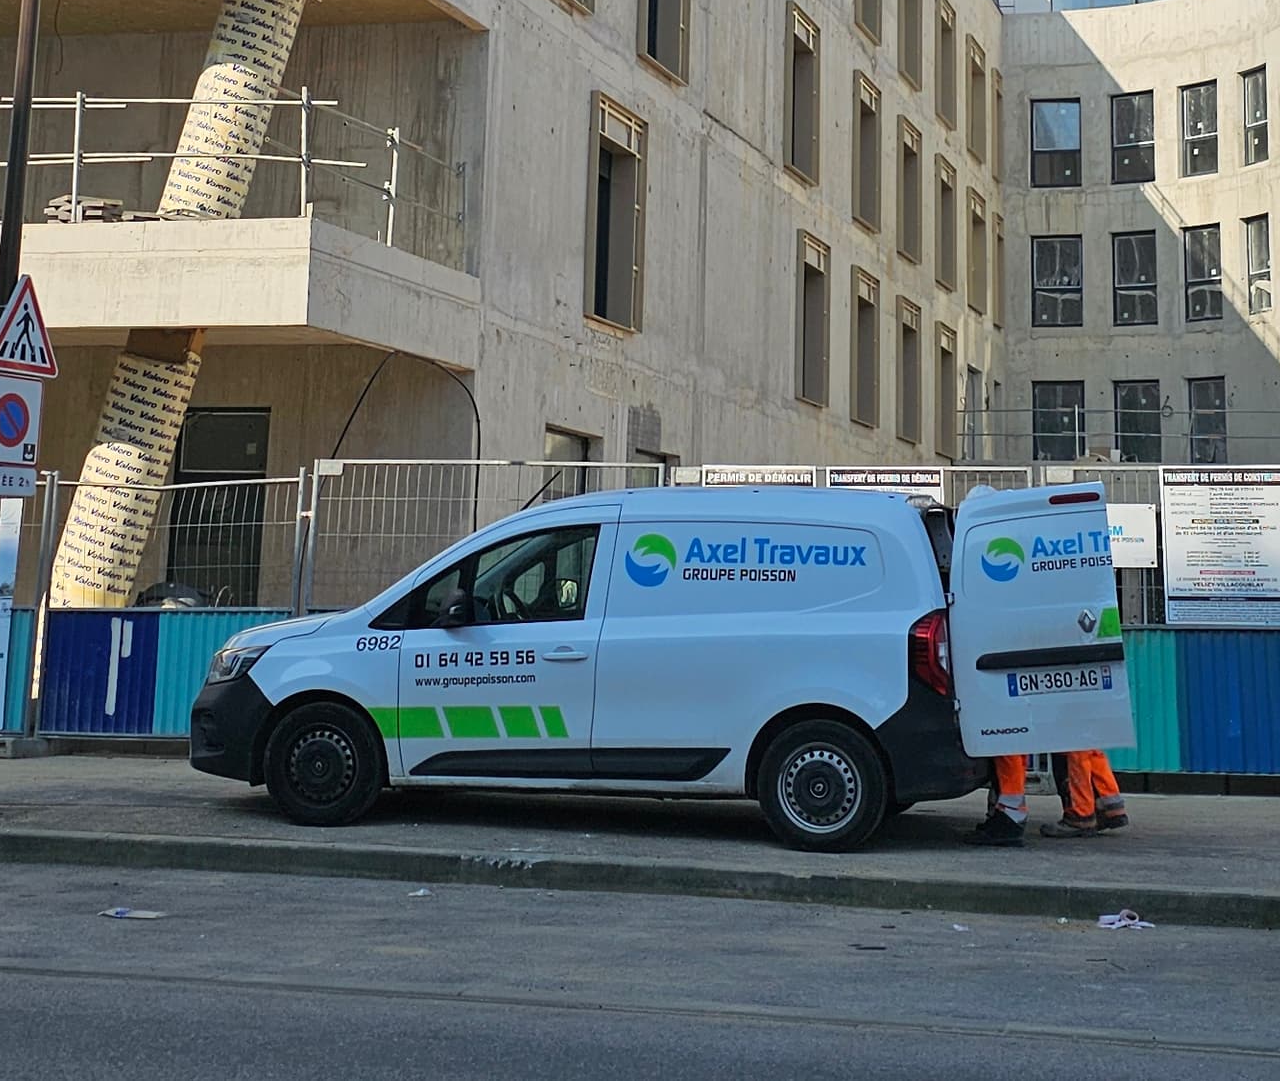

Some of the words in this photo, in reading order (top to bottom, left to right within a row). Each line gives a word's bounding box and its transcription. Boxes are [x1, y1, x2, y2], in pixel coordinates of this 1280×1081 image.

[143, 370, 169, 384] Valero
[123, 377, 147, 391] Valero
[152, 387, 177, 400] Valero
[112, 401, 134, 415] Valero
[130, 394, 157, 408] Valero
[119, 418, 144, 432] Valero
[128, 435, 154, 449] Valero
[107, 442, 132, 456] Valero
[138, 453, 160, 464] Valero
[115, 460, 141, 473] Valero
[96, 469, 119, 480] Valero
[707, 473, 745, 483] PERMIS
[748, 473, 764, 483] DE
[765, 471, 812, 483] DÉMOLIR
[113, 501, 138, 514] Valero
[91, 509, 117, 522] Valero
[100, 526, 126, 539] Valero
[111, 542, 133, 554] Valero
[685, 537, 746, 564] Axel
[754, 537, 866, 566] Travaux
[1032, 532, 1083, 558] Axel
[88, 550, 114, 563] Valero
[68, 557, 91, 571] Valero
[1032, 558, 1076, 572] GROUPE
[75, 575, 101, 589] Valero
[683, 568, 735, 581] GROUPE
[740, 569, 796, 582] POISSON
[356, 635, 401, 652] 6982
[415, 654, 430, 669] 01
[439, 652, 458, 667] 64
[464, 652, 484, 667] 42
[490, 651, 510, 666] 59
[515, 650, 535, 665] 56
[415, 673, 536, 689] www.groupepoisson.com
[1019, 670, 1098, 692] GN-360-AG
